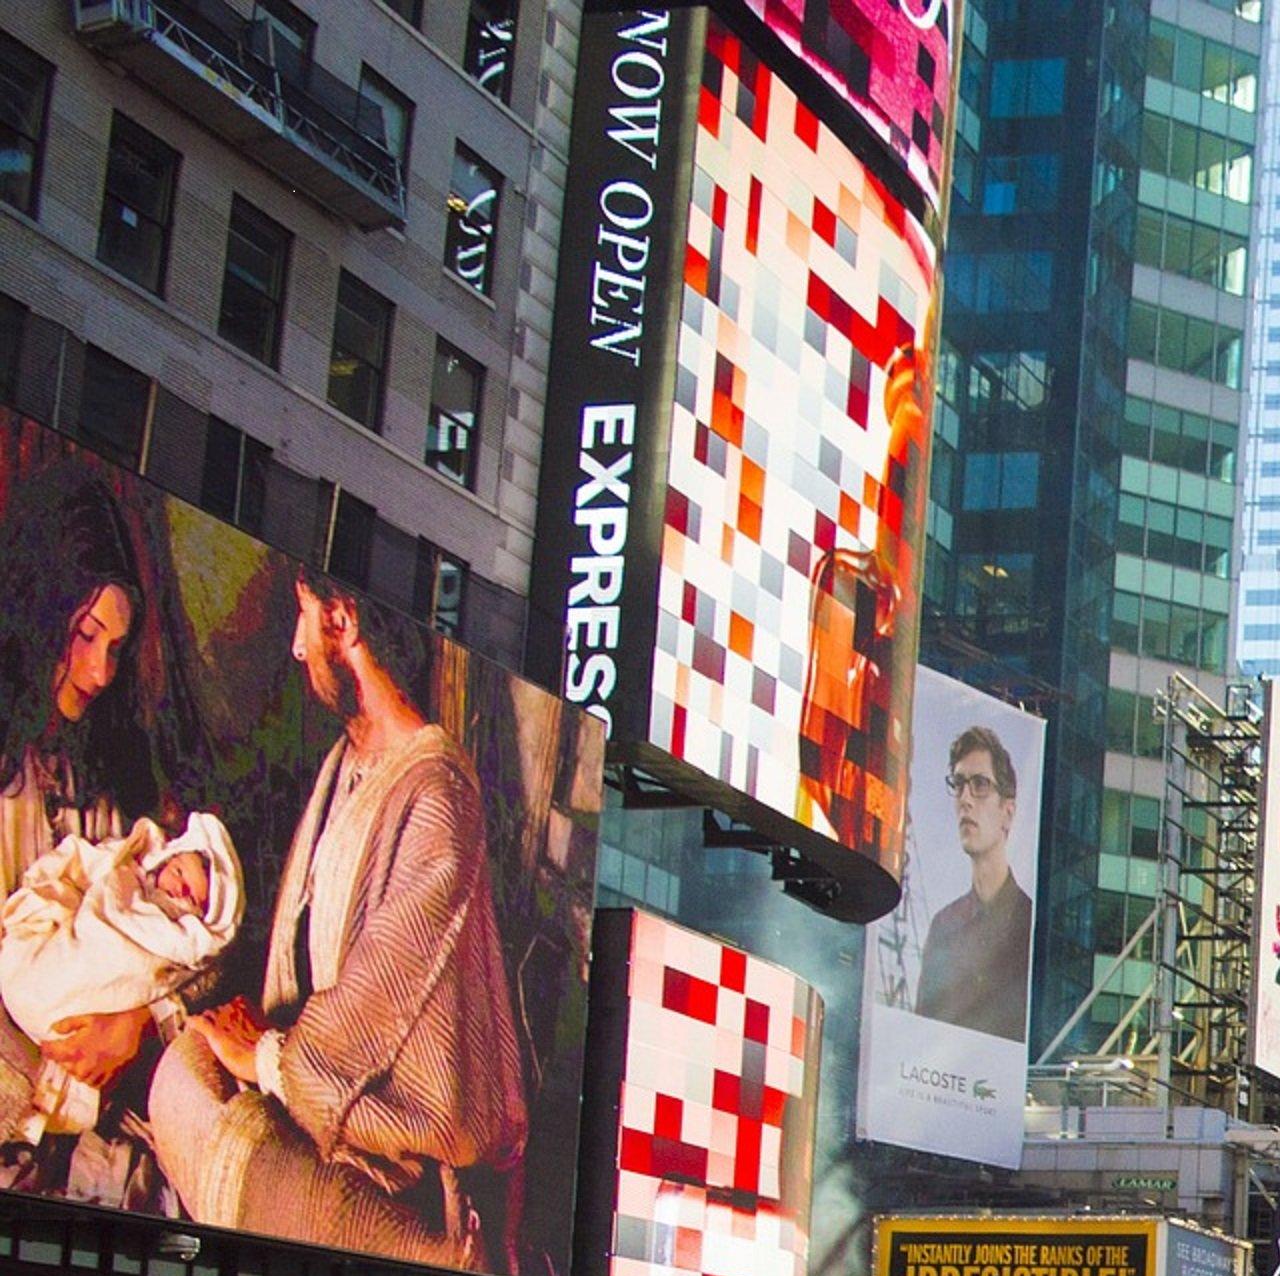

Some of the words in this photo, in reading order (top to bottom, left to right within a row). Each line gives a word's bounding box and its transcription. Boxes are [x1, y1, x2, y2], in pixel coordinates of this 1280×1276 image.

[608, 10, 669, 169] NOW
[589, 181, 653, 367] OPEN
[900, 1062, 967, 1094] LACOSTE
[1118, 1178, 1172, 1190] LAMAR
[973, 1244, 1012, 1266] JOINS
[1013, 1245, 1037, 1266] THE
[1041, 1246, 1083, 1267] RANKS
[1086, 1246, 1105, 1267] OF
[1106, 1246, 1130, 1268] THE
